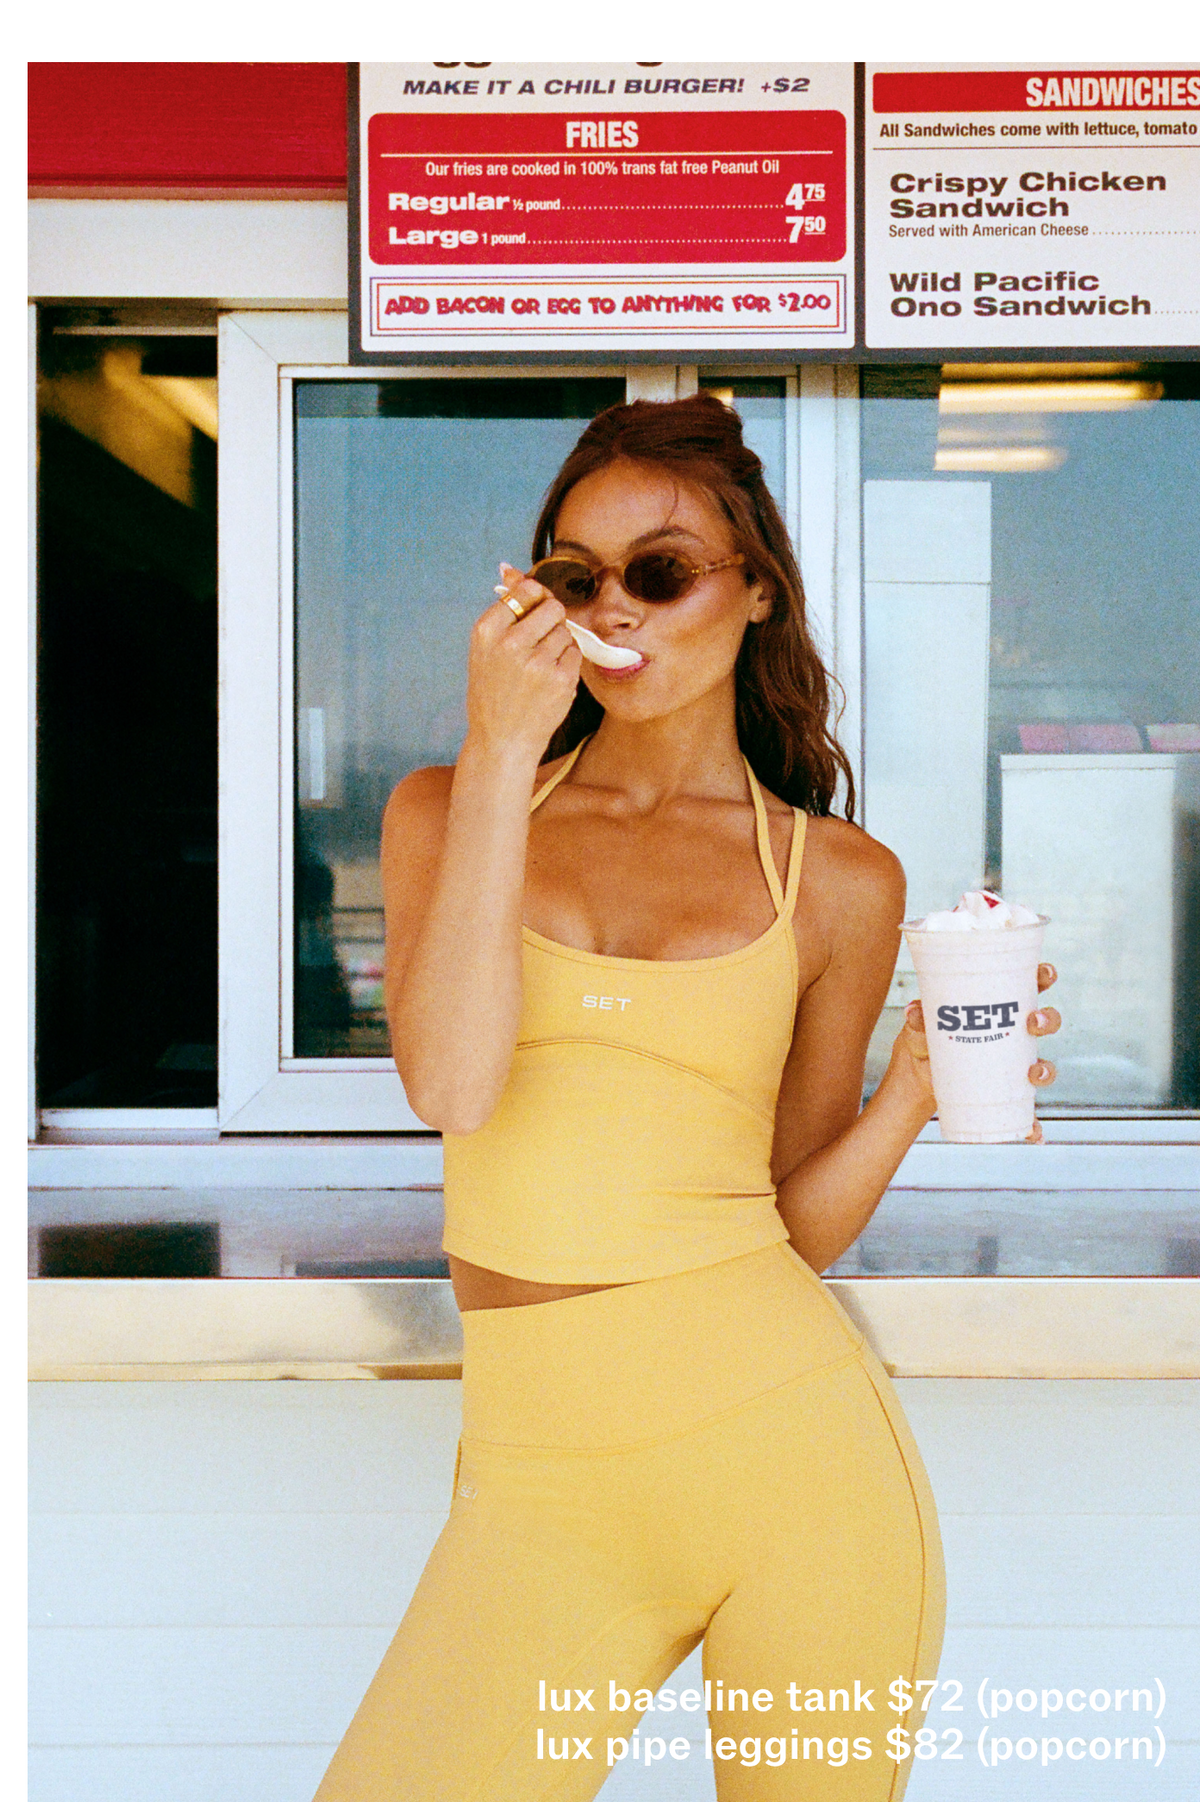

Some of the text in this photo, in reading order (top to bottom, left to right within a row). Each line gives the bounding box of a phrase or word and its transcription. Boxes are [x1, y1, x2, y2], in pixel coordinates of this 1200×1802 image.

[403, 78, 810, 95] MAKE IT A CHILI BURGER! +$2
[566, 121, 638, 148] FRIES
[880, 124, 898, 137] All
[905, 123, 995, 137] Sandwiches
[1001, 125, 1041, 136] come
[1046, 122, 1079, 135] with
[1085, 122, 1139, 137] lettuce,
[426, 159, 779, 176] Our fries are cooked in 100% trans fat free Peanut Oil
[890, 171, 1166, 197] Crispy Chicken
[389, 192, 510, 215] Regular
[890, 197, 1068, 218] Sandwich
[389, 227, 479, 249] Large
[482, 233, 487, 244] 1
[889, 223, 1088, 237] Served with American Cheese
[890, 271, 1099, 292] Wild Pacific
[385, 292, 831, 315] ADD BACON OR EGG TO ANYTHING FOR $2.00
[891, 296, 1150, 317] Ono Sandwich
[582, 995, 631, 1011] SET
[937, 1002, 1019, 1031] SET
[984, 1033, 1003, 1042] FAIR
